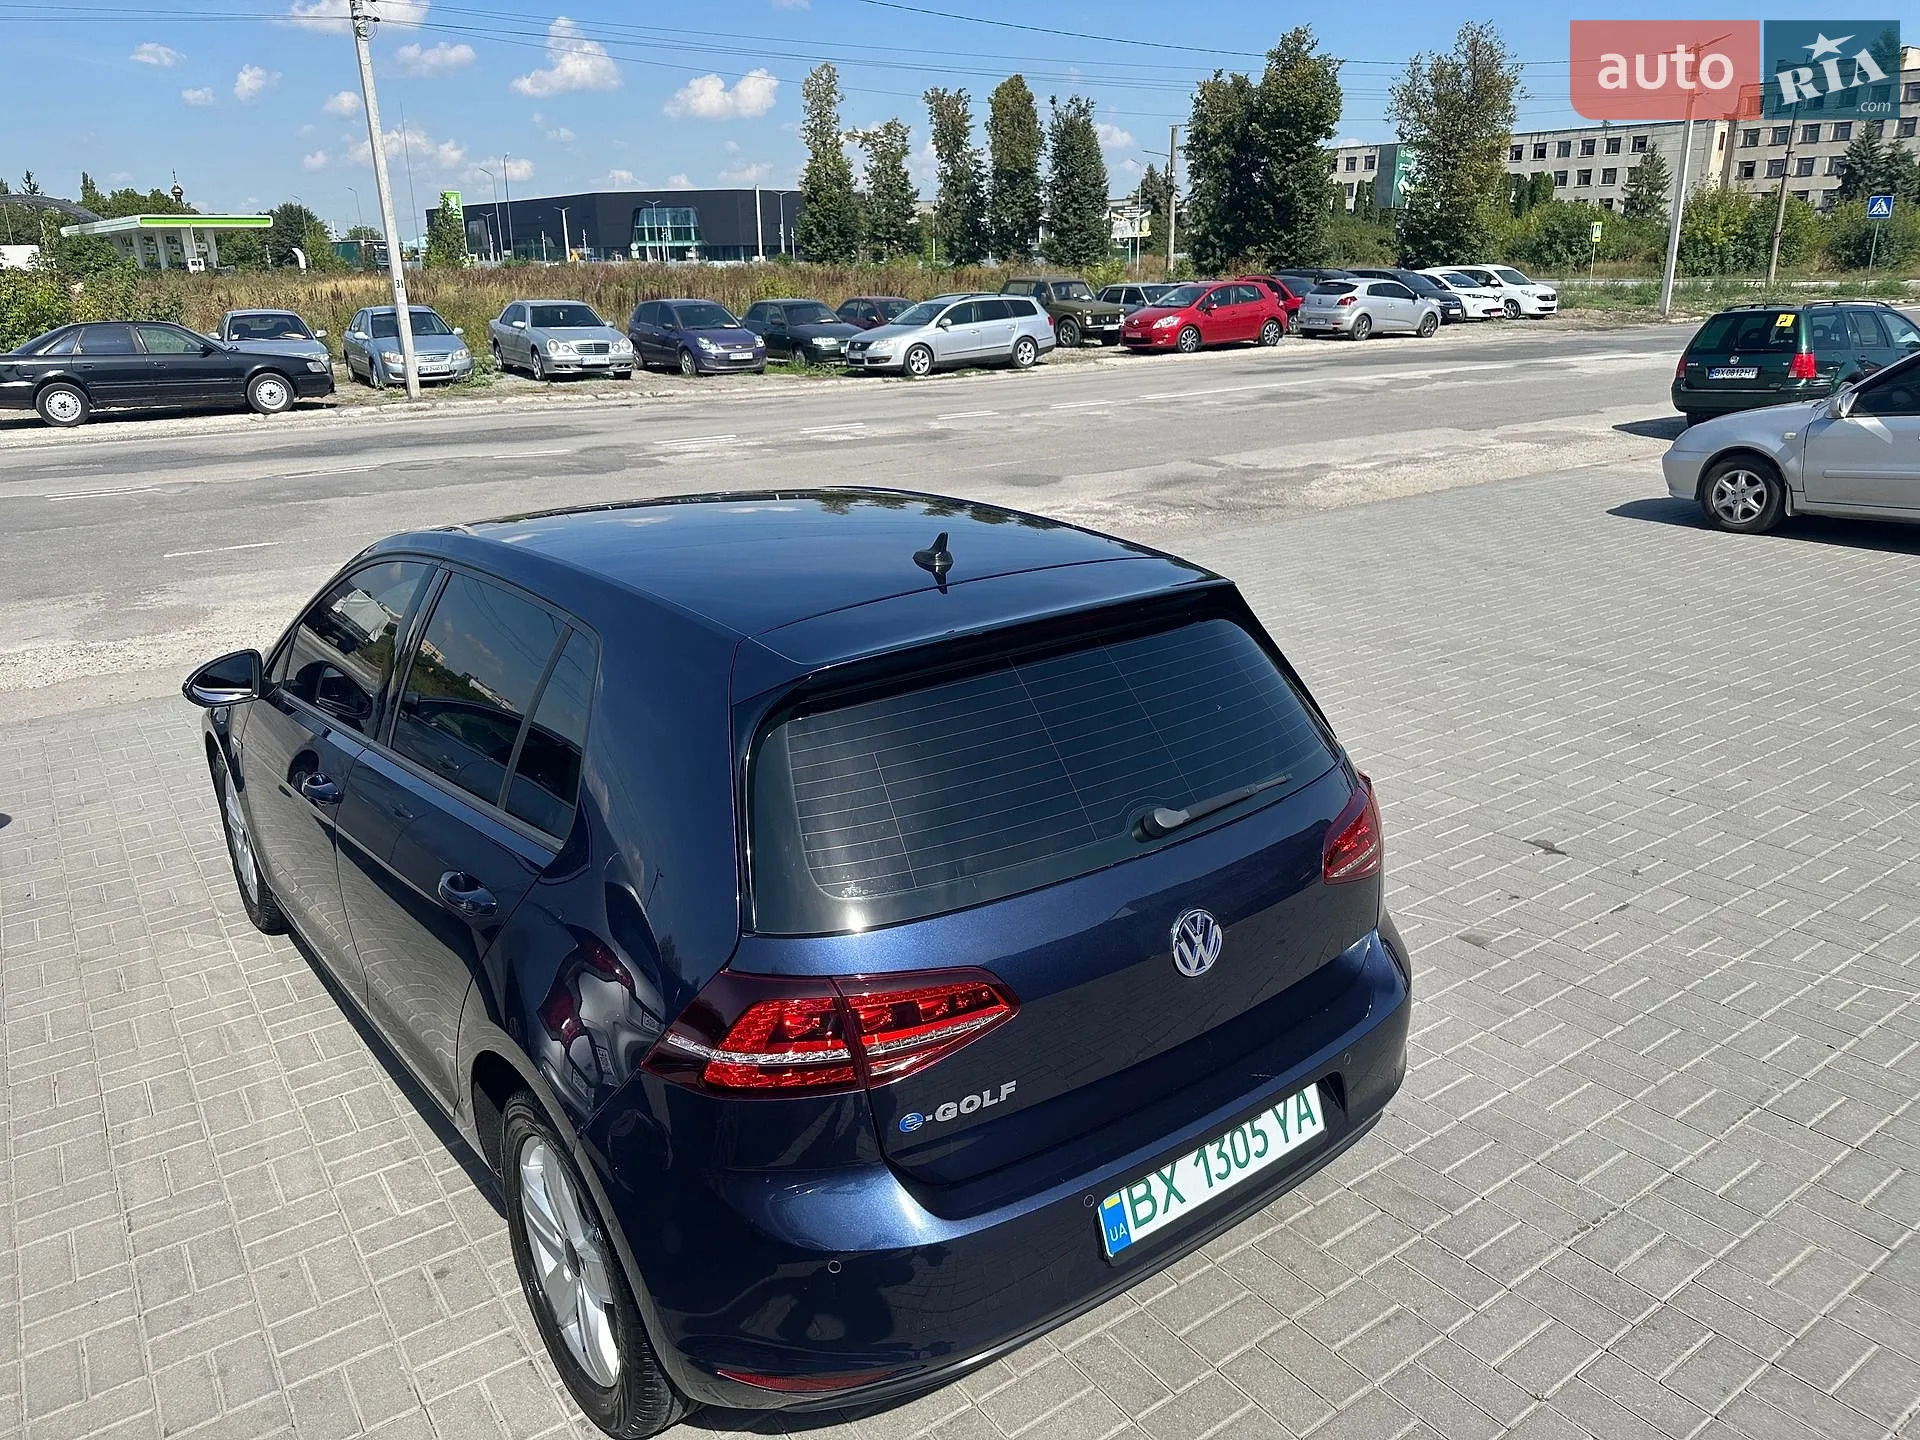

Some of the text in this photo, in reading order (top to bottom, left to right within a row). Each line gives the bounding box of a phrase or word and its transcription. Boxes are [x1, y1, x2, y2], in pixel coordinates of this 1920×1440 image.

[1127, 1090, 1317, 1229] BX 1305 YA
[1109, 1222, 1128, 1242] UA
